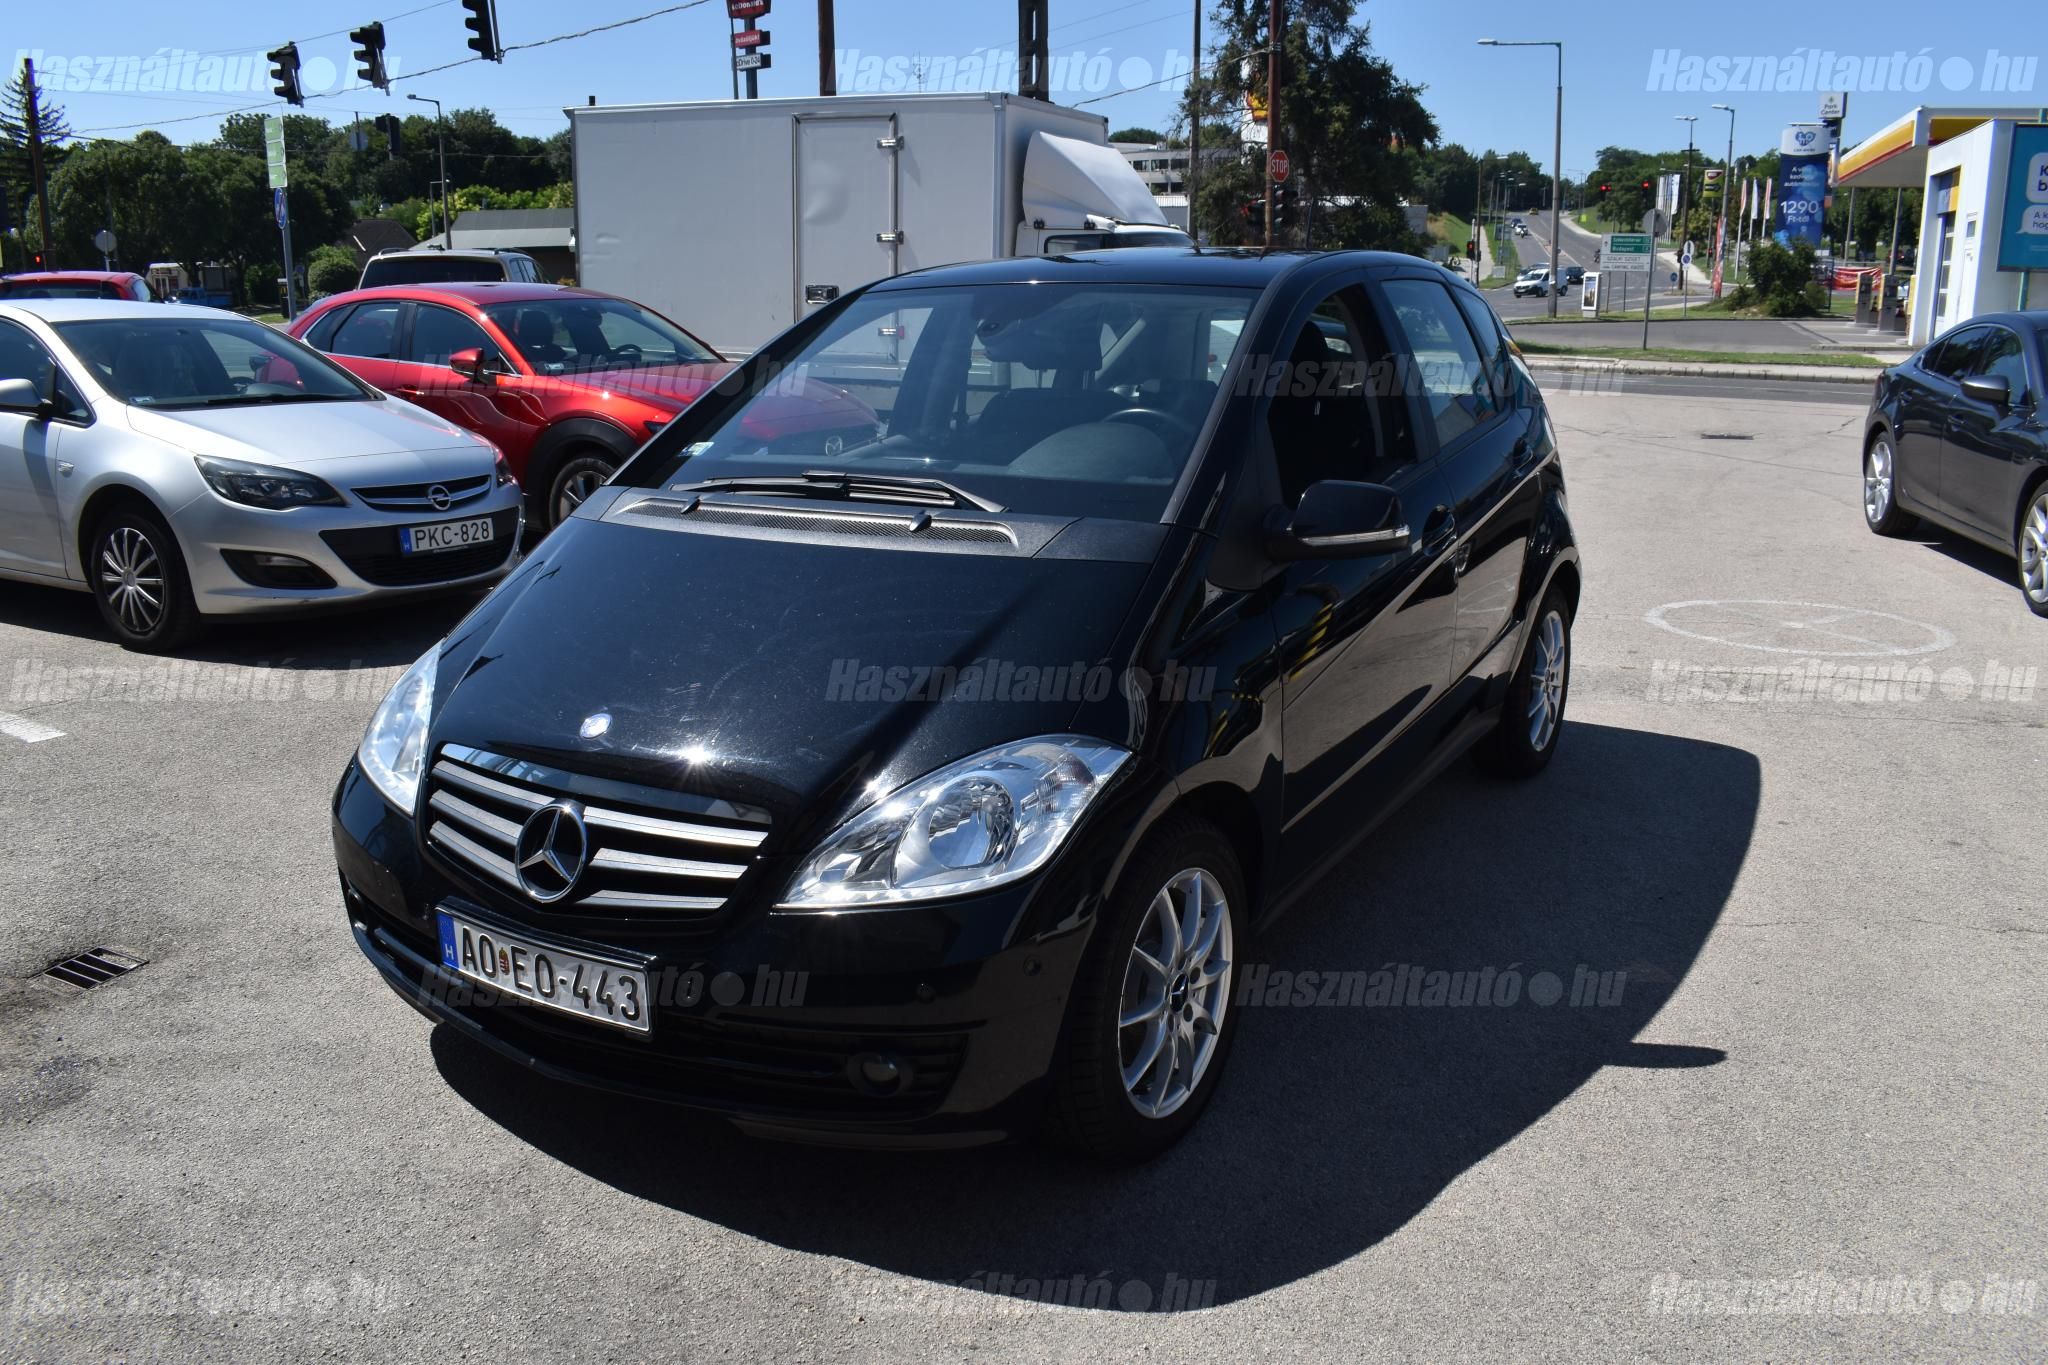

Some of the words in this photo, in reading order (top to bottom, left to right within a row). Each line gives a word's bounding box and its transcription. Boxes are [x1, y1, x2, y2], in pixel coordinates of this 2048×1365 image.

[1271, 159, 1288, 173] STOP
[1780, 200, 1819, 214] 1290
[2034, 211, 2041, 219] A
[414, 520, 490, 549] PKC-828
[444, 943, 455, 960] H
